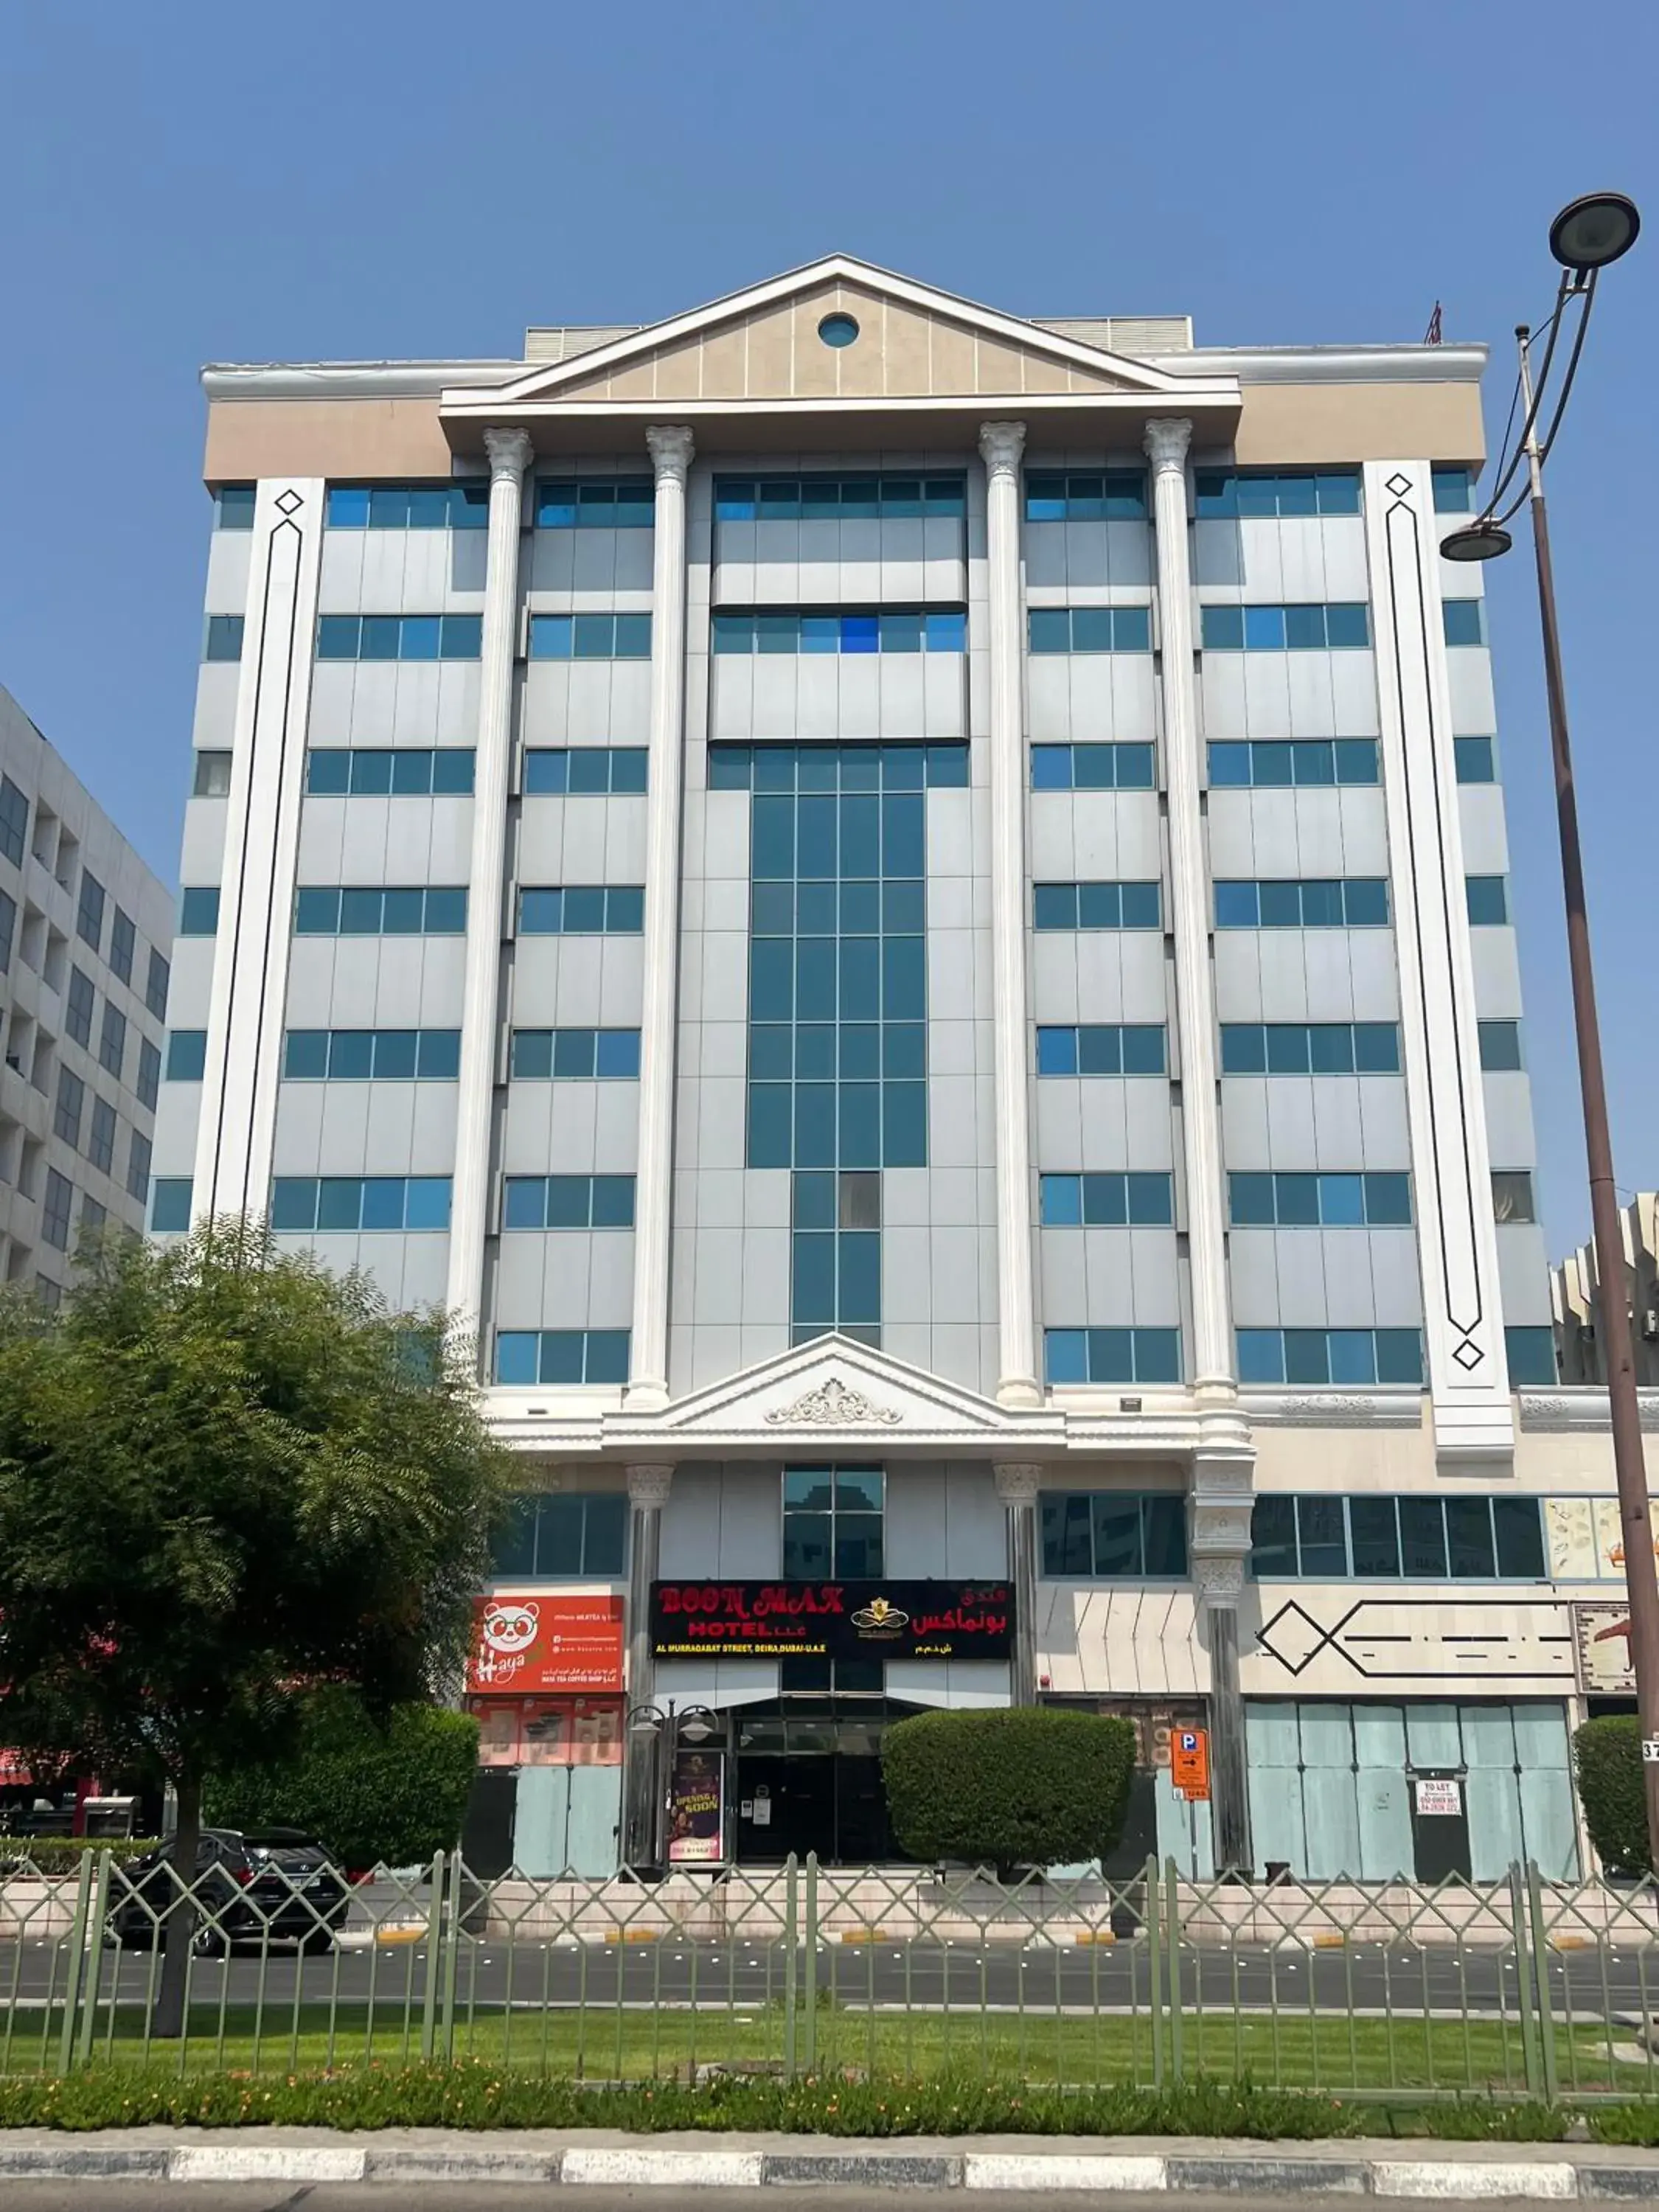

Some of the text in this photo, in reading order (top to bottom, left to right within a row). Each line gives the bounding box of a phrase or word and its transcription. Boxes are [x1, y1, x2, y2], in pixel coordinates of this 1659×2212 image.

[659, 1587, 844, 1619] BOON MAX
[689, 1622, 773, 1637] HOTEL
[912, 1607, 1006, 1635] بونماكس
[655, 1644, 667, 1652] AL
[476, 1643, 525, 1683] Haya
[1183, 1733, 1195, 1750] P
